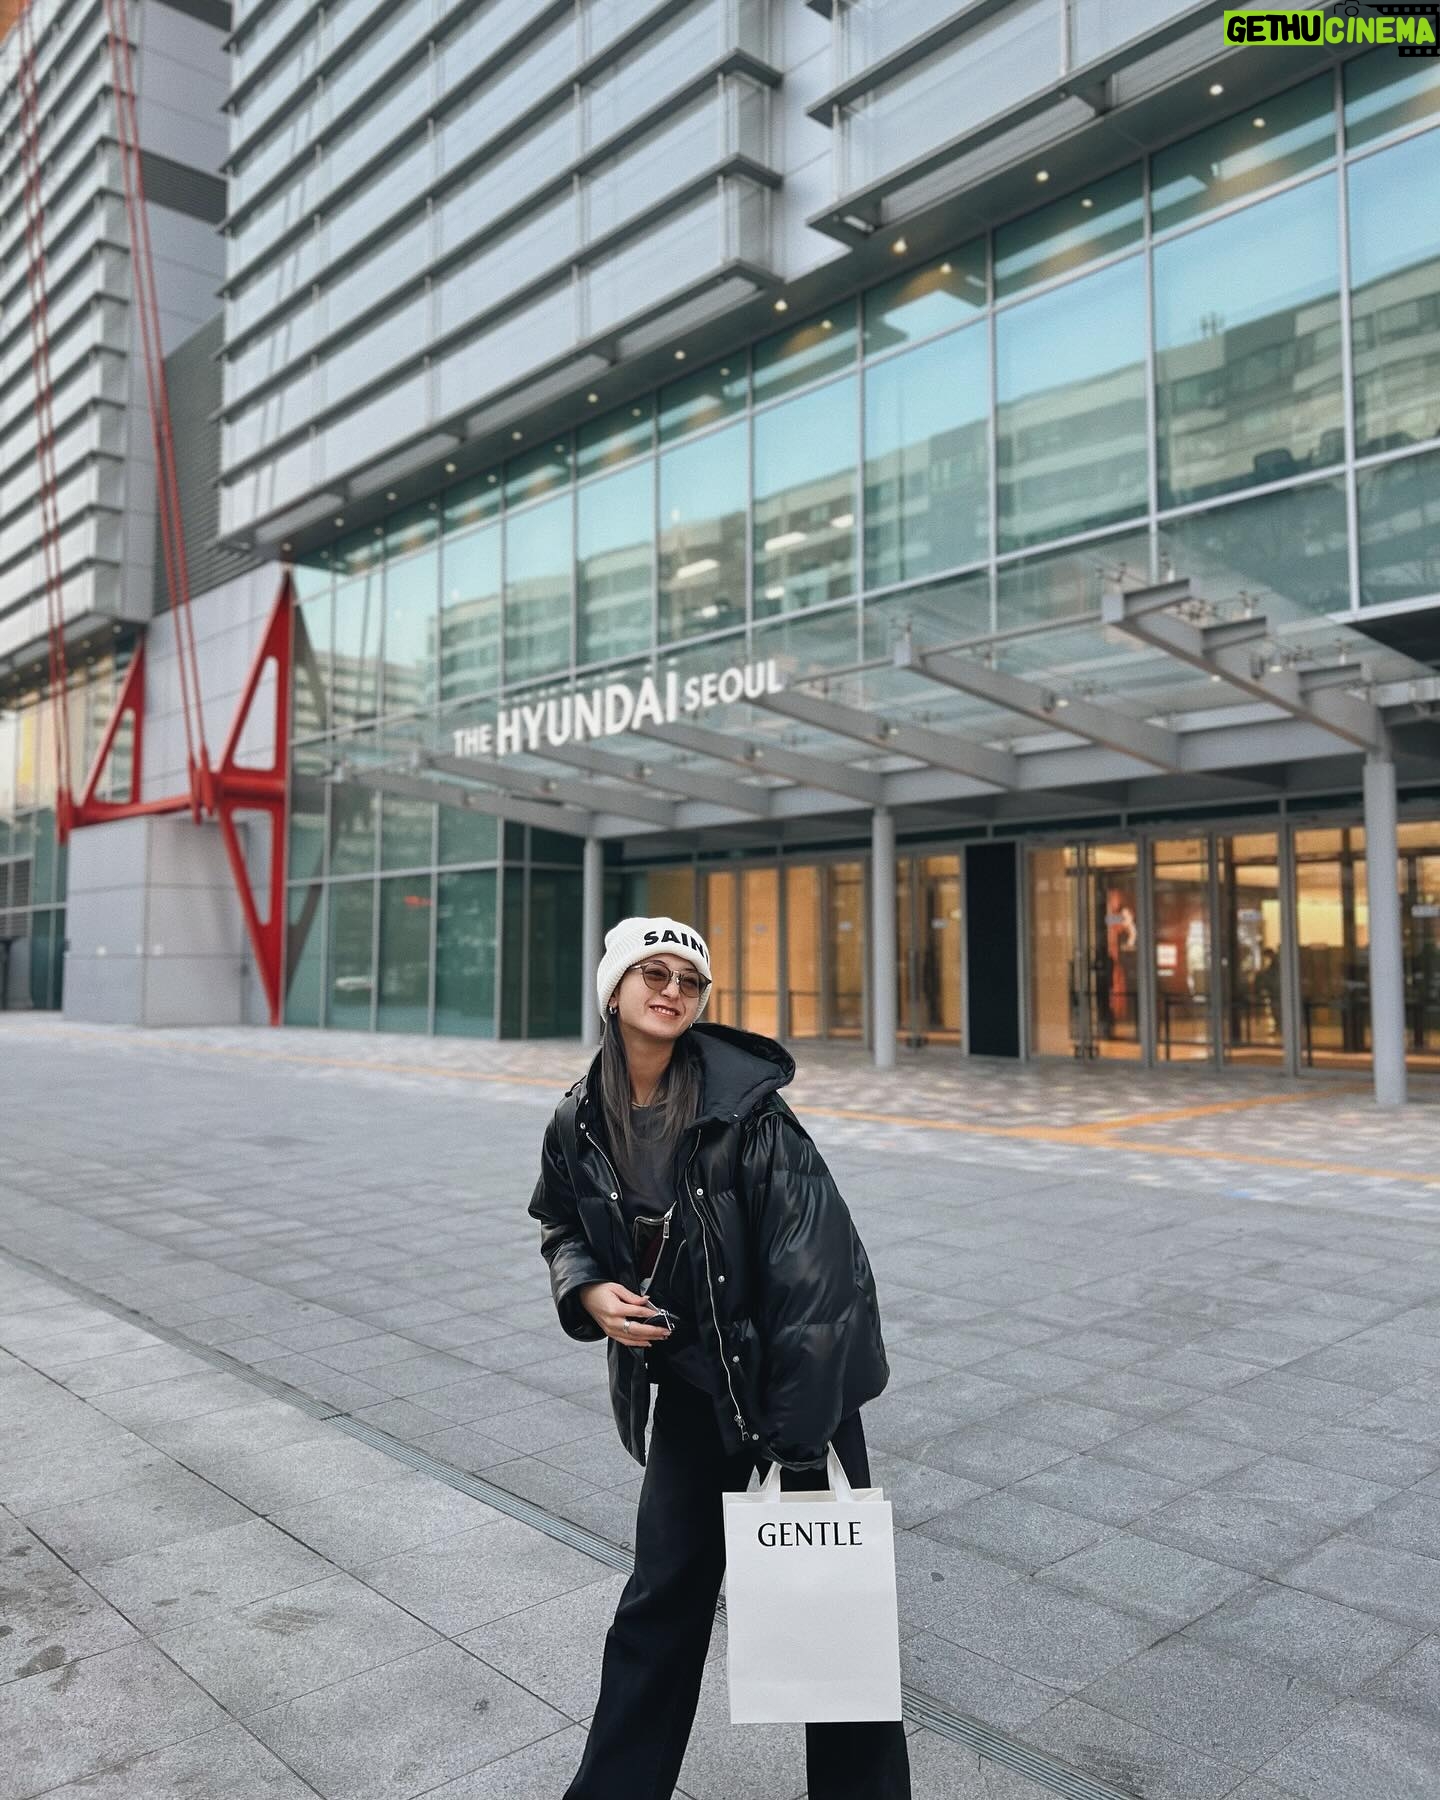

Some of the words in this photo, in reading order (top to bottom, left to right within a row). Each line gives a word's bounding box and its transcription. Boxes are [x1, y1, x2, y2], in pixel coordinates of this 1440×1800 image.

[454, 724, 493, 757] THE
[497, 671, 678, 755] HYUNDAI
[684, 659, 783, 711] SEOUL
[757, 1521, 863, 1547] GENTLE
